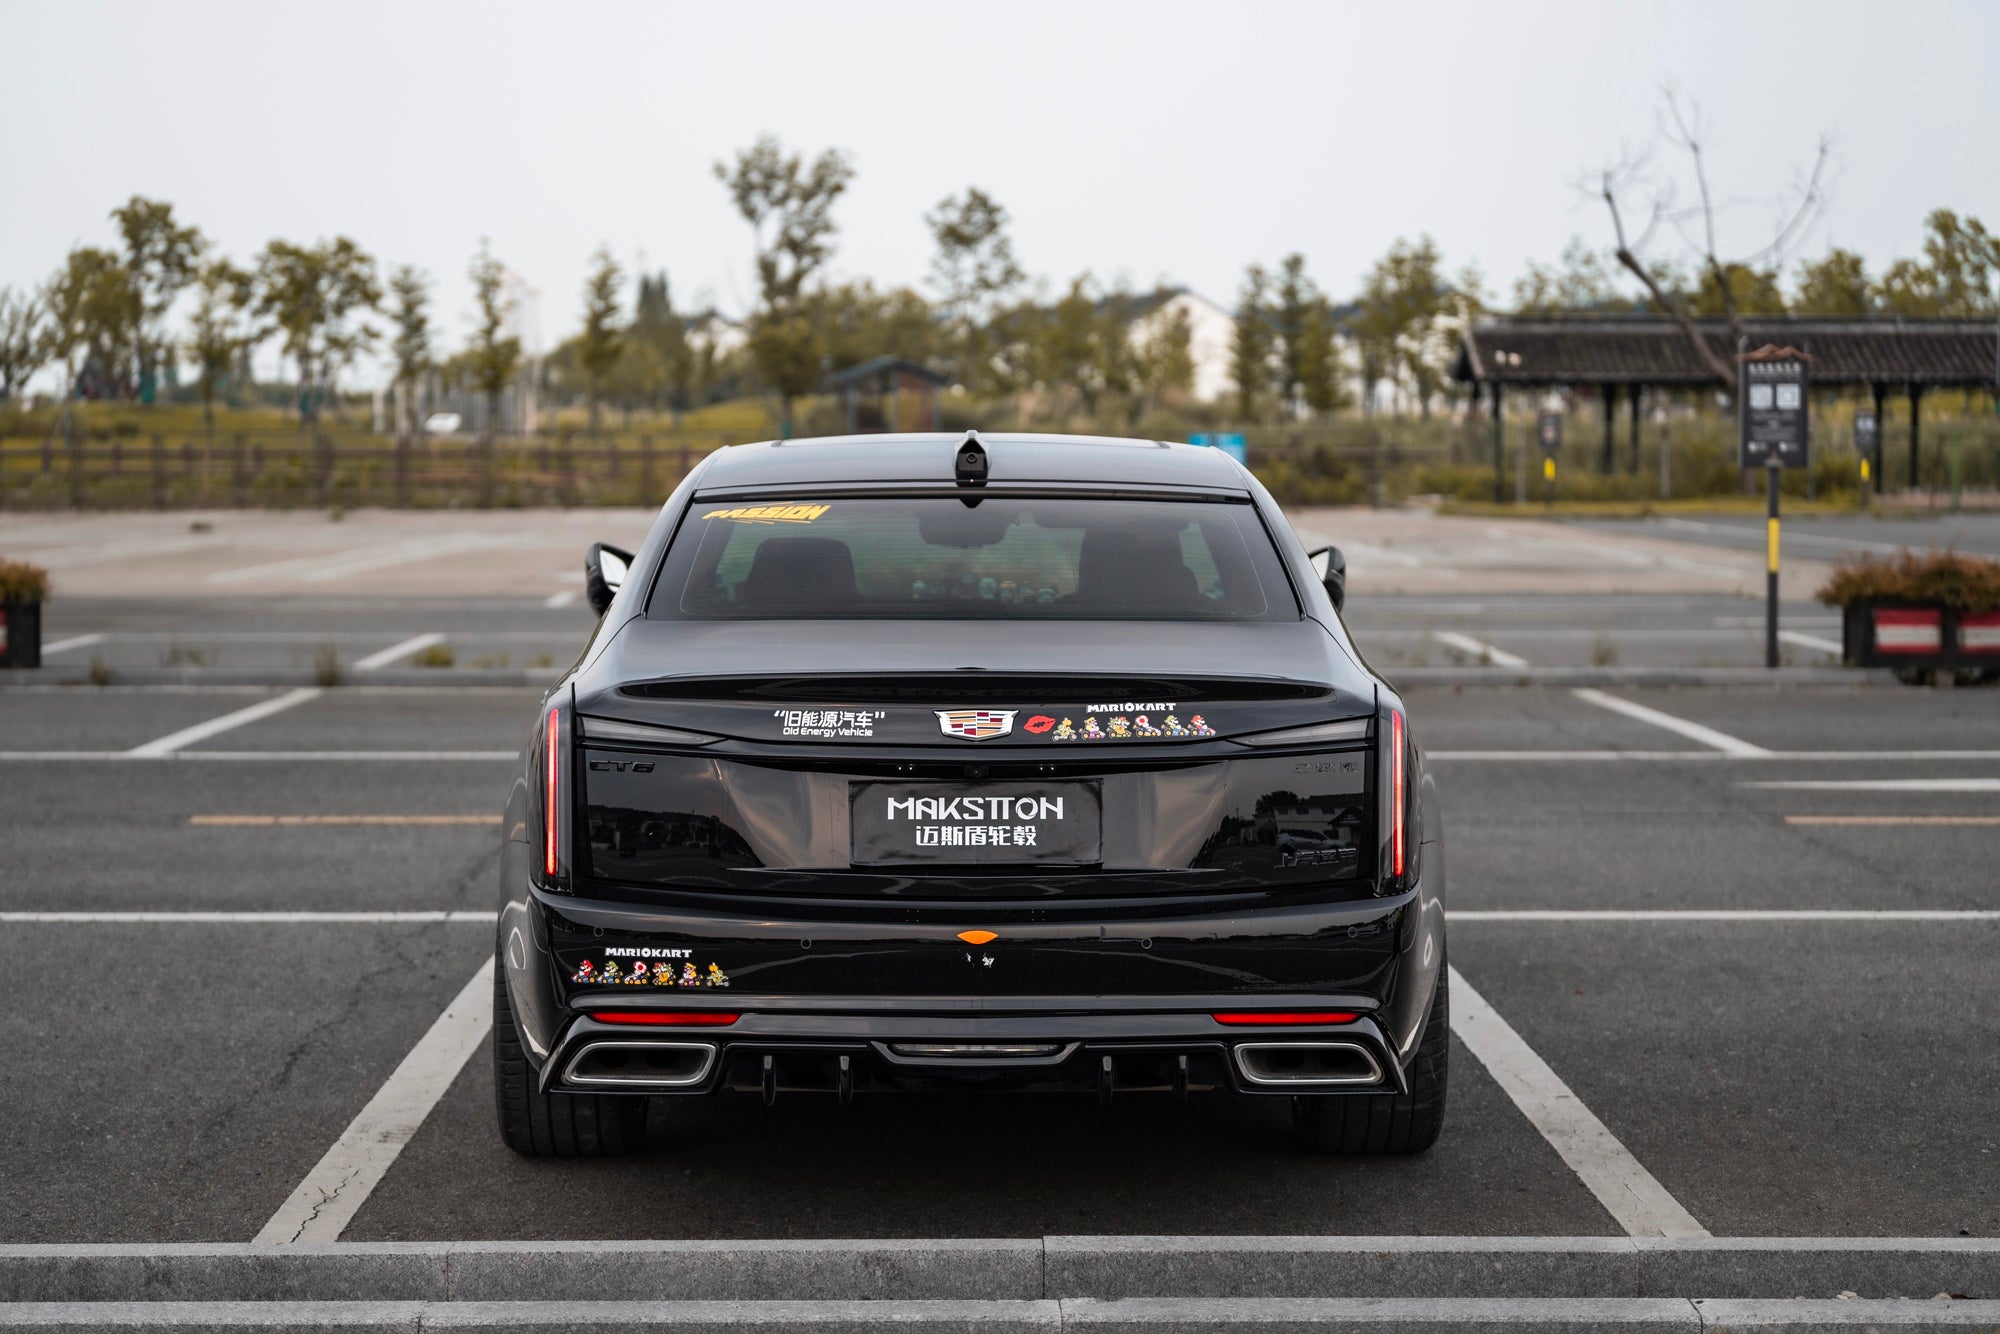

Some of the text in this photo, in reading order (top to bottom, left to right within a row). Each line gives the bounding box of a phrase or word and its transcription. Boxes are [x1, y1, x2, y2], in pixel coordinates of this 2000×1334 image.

[702, 504, 832, 520] PASSION
[782, 727, 873, 738] Old Energy Vehicle
[589, 760, 656, 773] CT6
[887, 797, 1064, 820] MAKSTTON
[915, 825, 1037, 846] 迈斯盾轮毂
